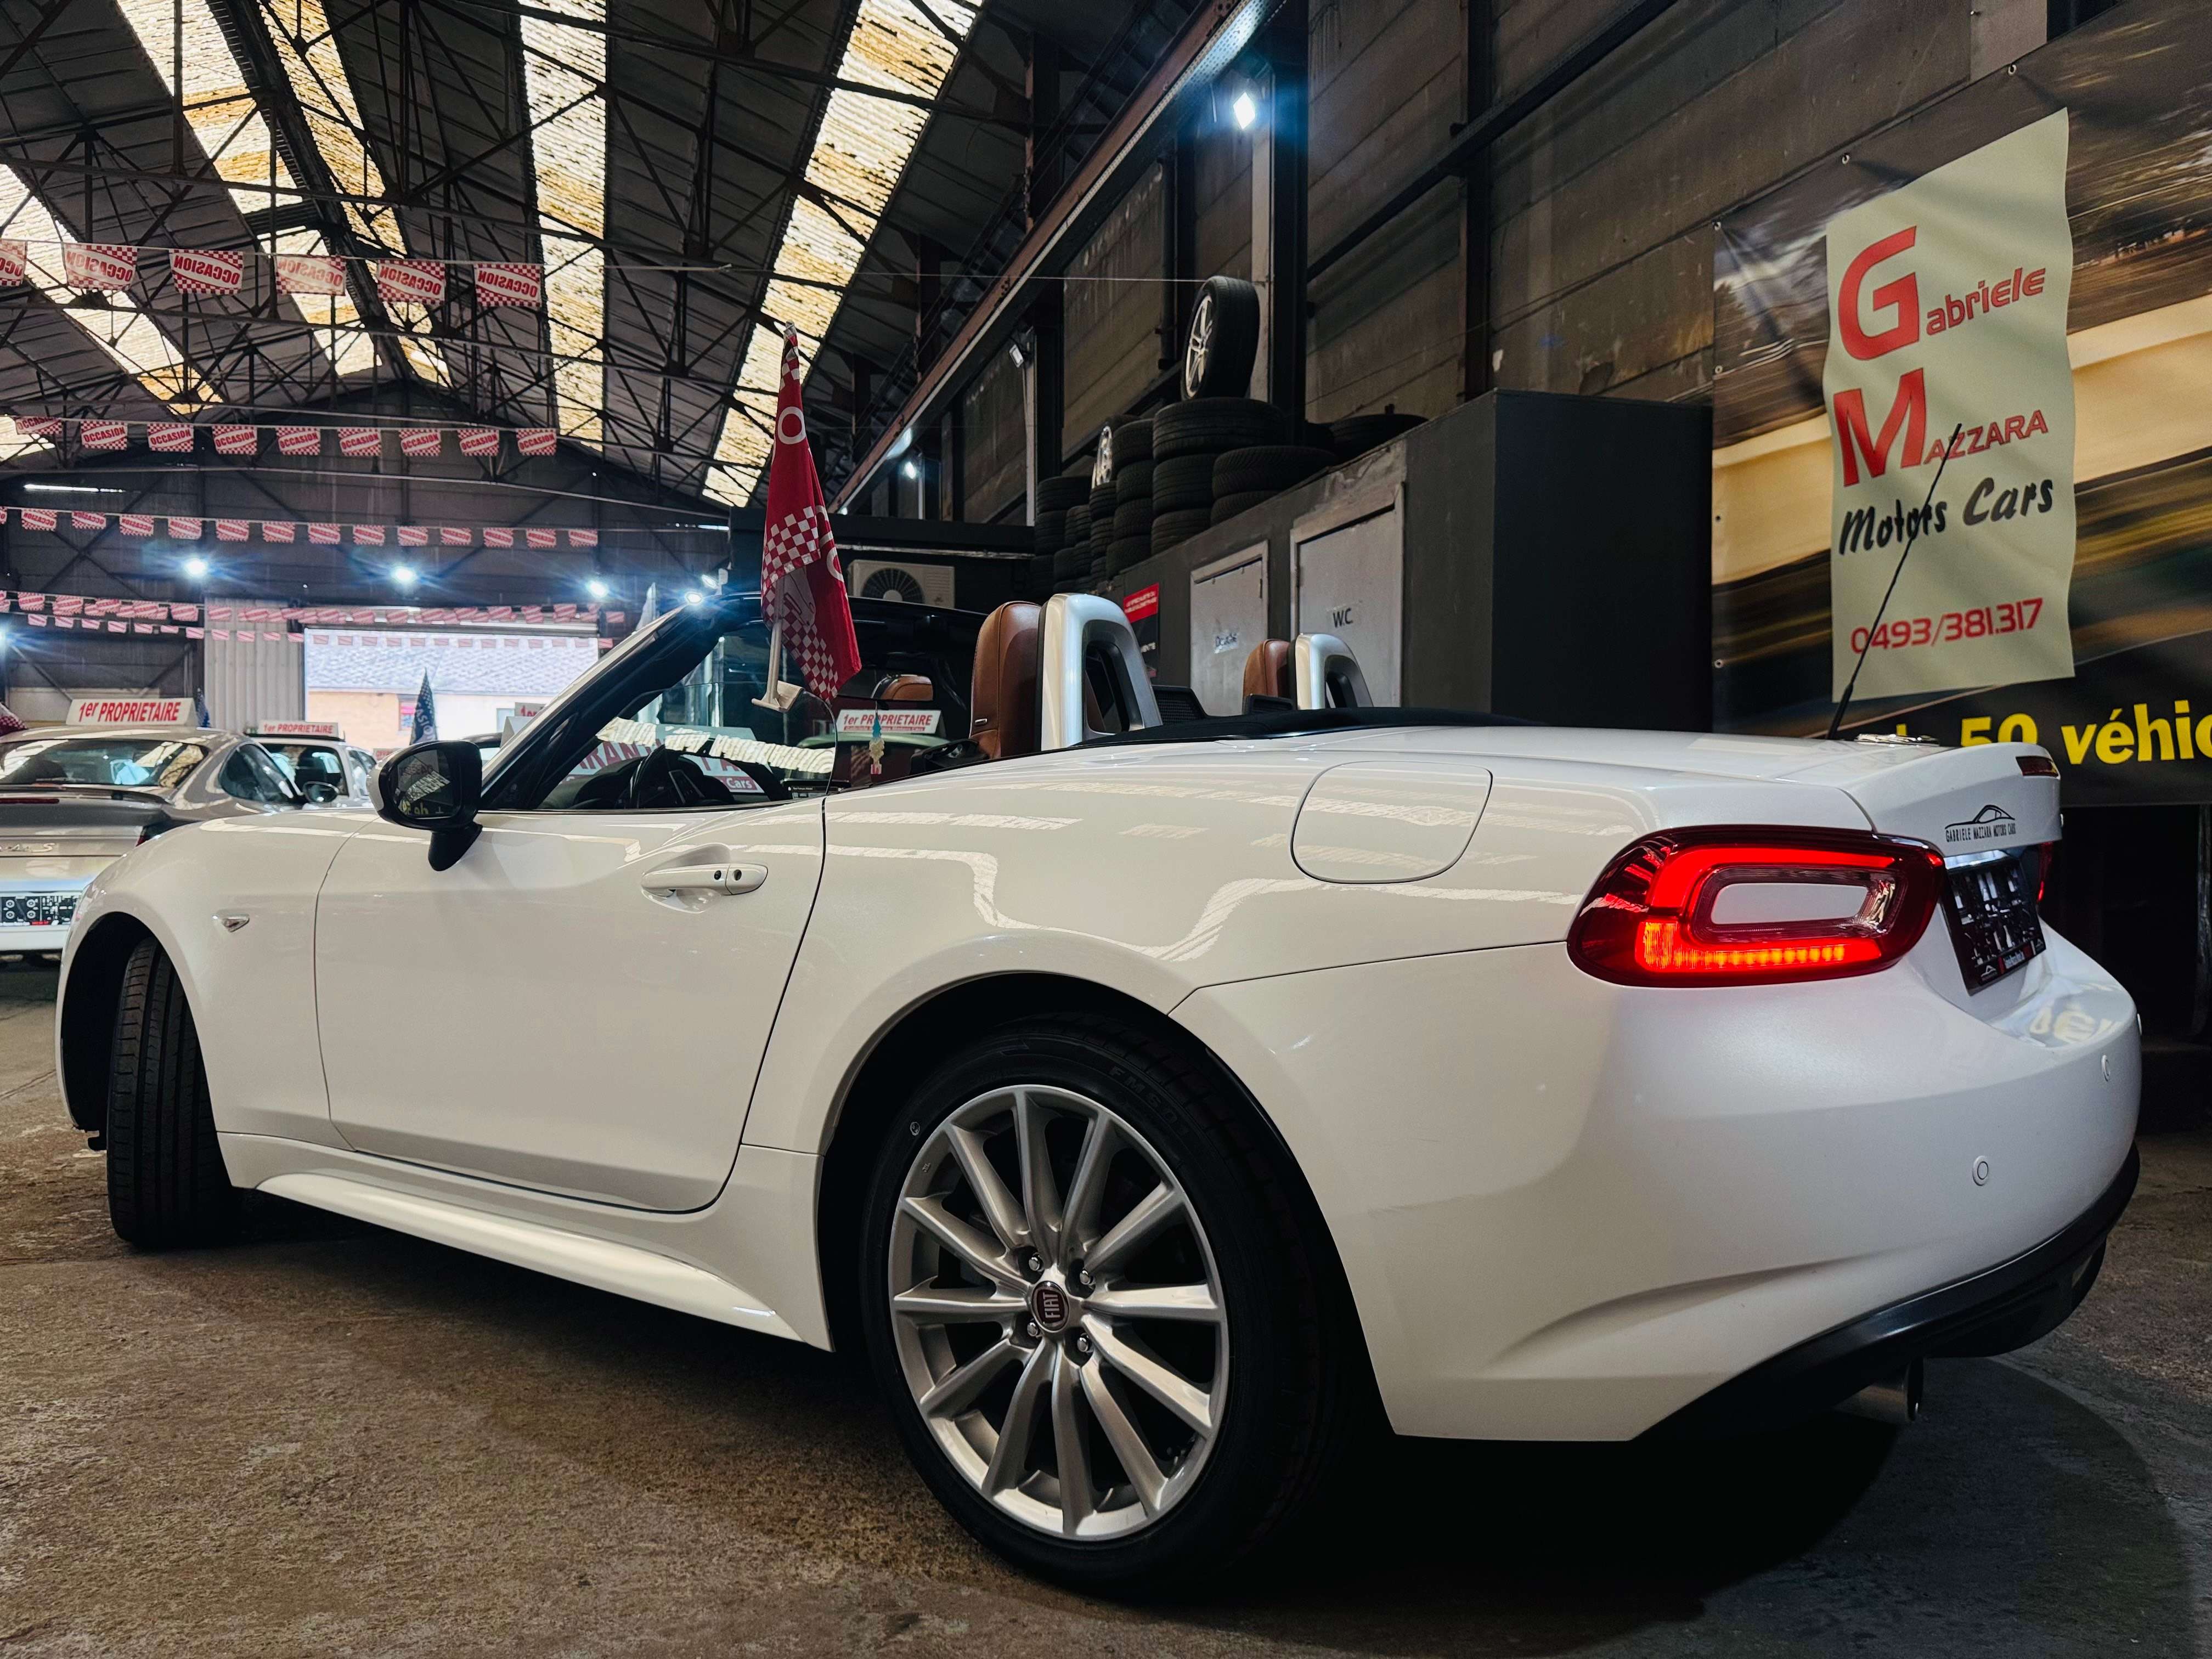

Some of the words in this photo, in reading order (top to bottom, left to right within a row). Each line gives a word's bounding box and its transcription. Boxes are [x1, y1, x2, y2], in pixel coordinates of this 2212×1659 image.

[1838, 225, 2046, 361] Gabriele
[83, 426, 126, 443] OCCASION
[150, 429, 191, 445] OCCASION
[216, 431, 255, 447] OCCASION
[279, 432, 319, 449] OCCASION
[341, 432, 380, 449] OCCASION
[402, 433, 439, 450] OCCASION
[460, 433, 498, 450] OCCASION
[520, 433, 556, 450] OCCASION
[1838, 499, 1947, 556] Motors
[1962, 476, 2053, 527] Cars
[1850, 597, 2043, 654] 0493/381.317
[79, 702, 98, 722] 1er
[97, 702, 181, 722] PROPRIETAIRE
[844, 714, 859, 725] 1er
[860, 714, 933, 725] PRPRIETAIRE
[277, 724, 334, 734] PROPRIETAIRE
[1961, 713, 2038, 747] 50
[726, 777, 753, 789] Cars
[1945, 827, 1971, 843] GABRIELE
[1042, 1291, 1061, 1318] FIAT
